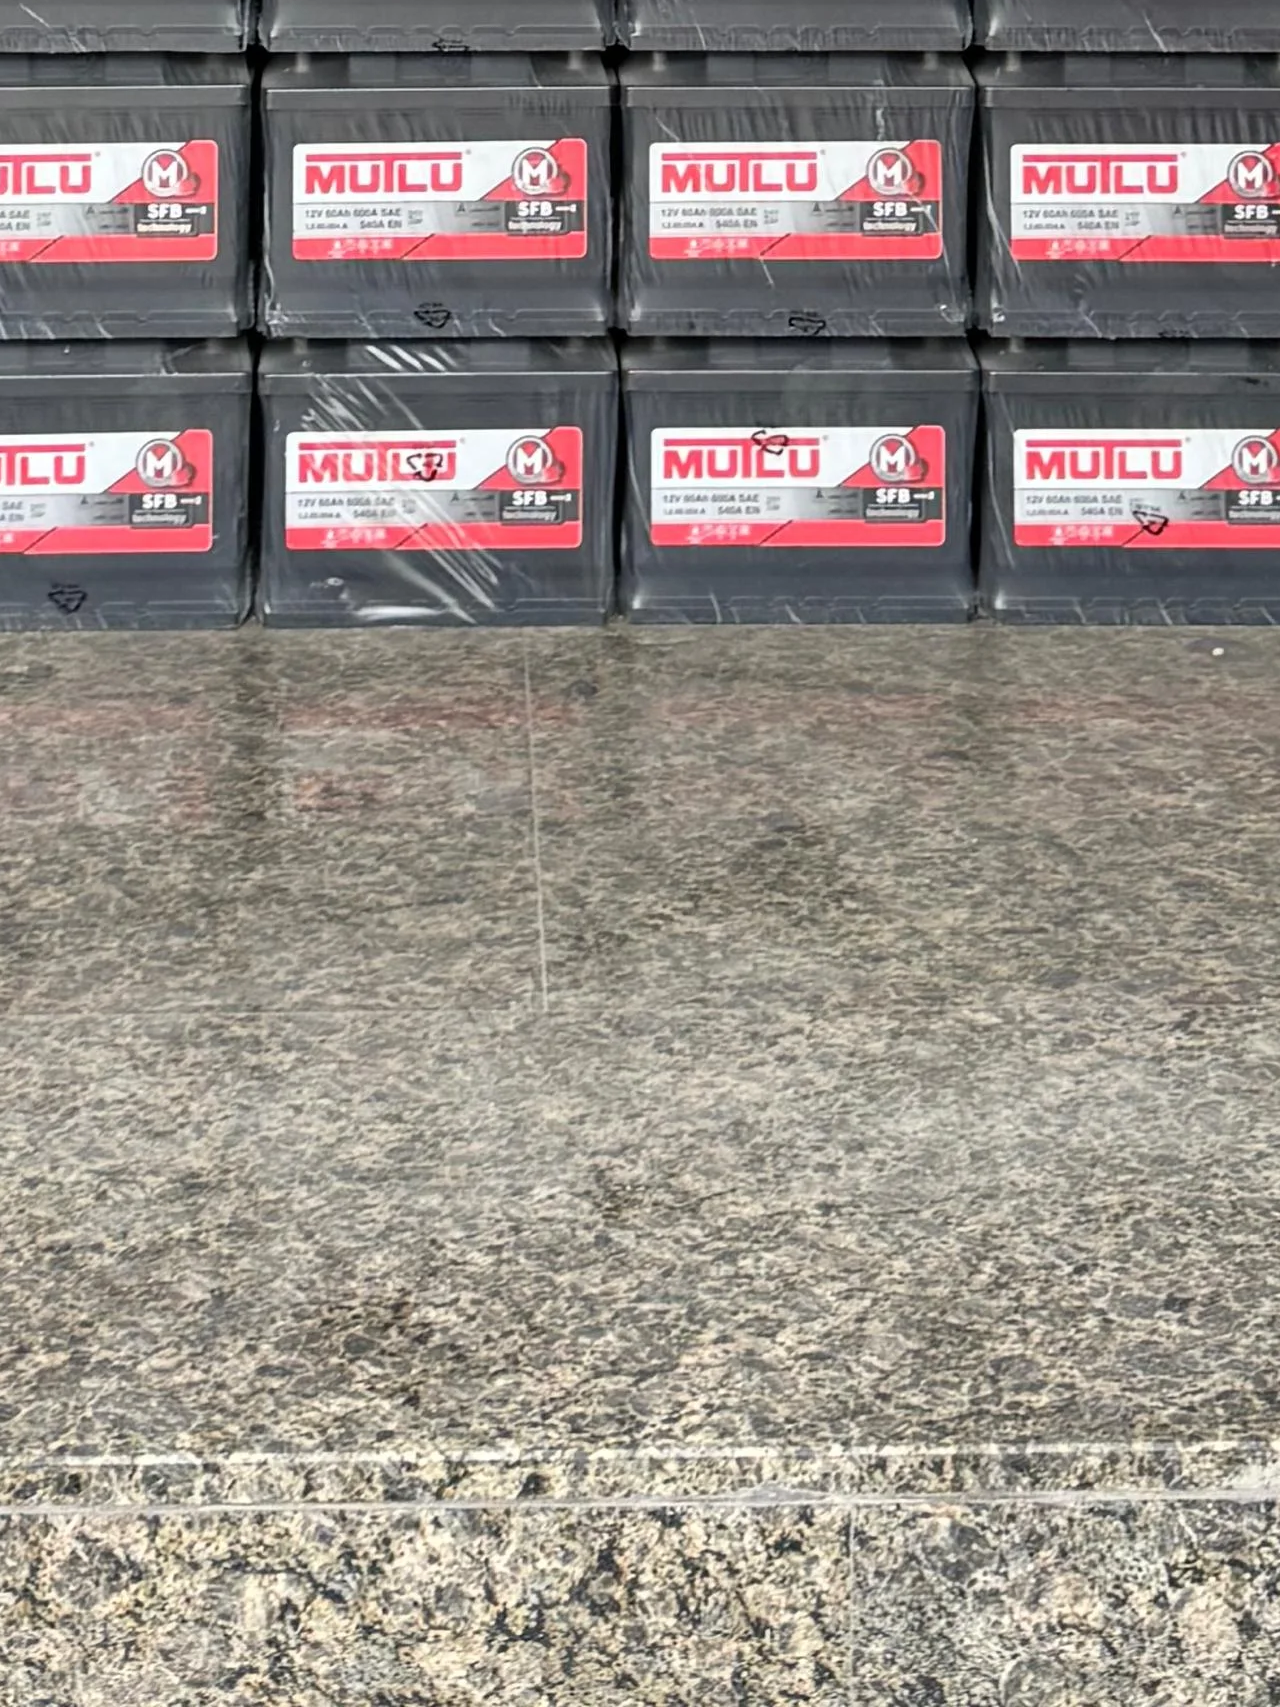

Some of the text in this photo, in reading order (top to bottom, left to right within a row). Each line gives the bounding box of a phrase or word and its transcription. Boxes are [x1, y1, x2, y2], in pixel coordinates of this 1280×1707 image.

[305, 152, 462, 194] MUTLU
[662, 152, 817, 193] MUTLU
[1022, 154, 1178, 194] MUTLU
[147, 204, 183, 220] SFB
[517, 202, 553, 216] SFB
[873, 202, 908, 216] SFB
[1234, 205, 1269, 219] SFB
[664, 437, 820, 479] MUTLU
[1026, 439, 1182, 479] MUTLU
[142, 494, 178, 509] SFB
[512, 491, 548, 505] SFB
[876, 489, 911, 503] SFB
[1238, 491, 1273, 505] SFB
